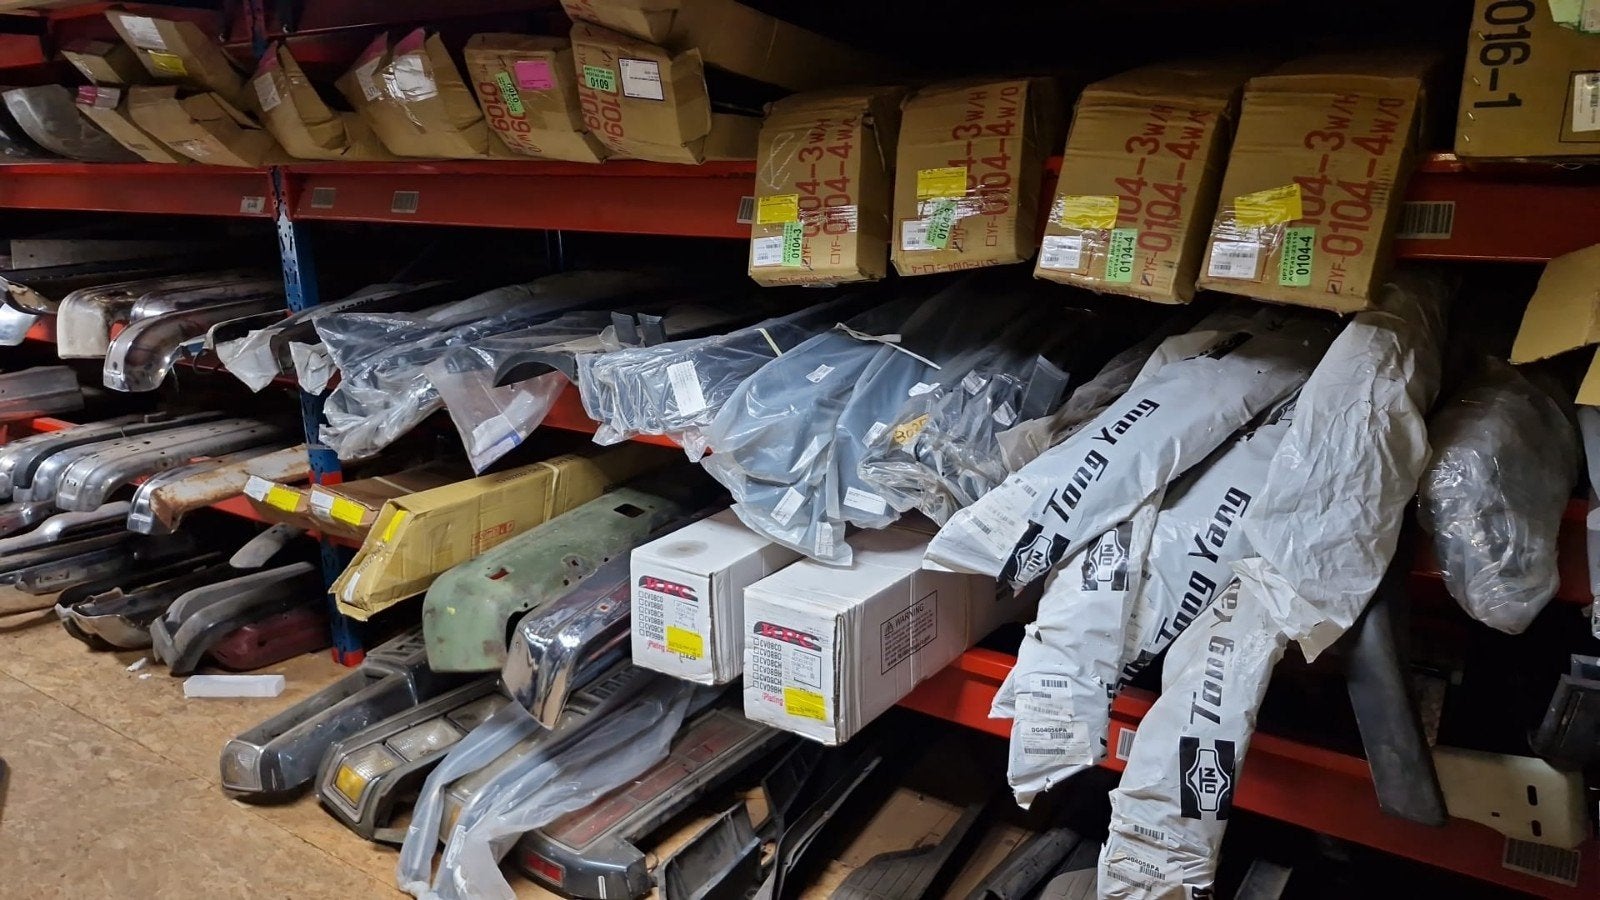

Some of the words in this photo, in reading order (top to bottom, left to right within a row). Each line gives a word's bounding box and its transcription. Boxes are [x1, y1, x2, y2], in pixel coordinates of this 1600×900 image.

[590, 76, 610, 90] 0109
[791, 227, 802, 259] 0104-3
[1118, 235, 1135, 273] 0104-4
[1296, 235, 1313, 275] 0104-4
[1042, 449, 1110, 523] Tong
[1091, 397, 1161, 446] Yang
[1153, 569, 1217, 647] Tong
[1187, 486, 1252, 564] Yang
[894, 603, 925, 627] WARNING
[1209, 576, 1243, 628] Yan
[1189, 634, 1235, 725] Tong
